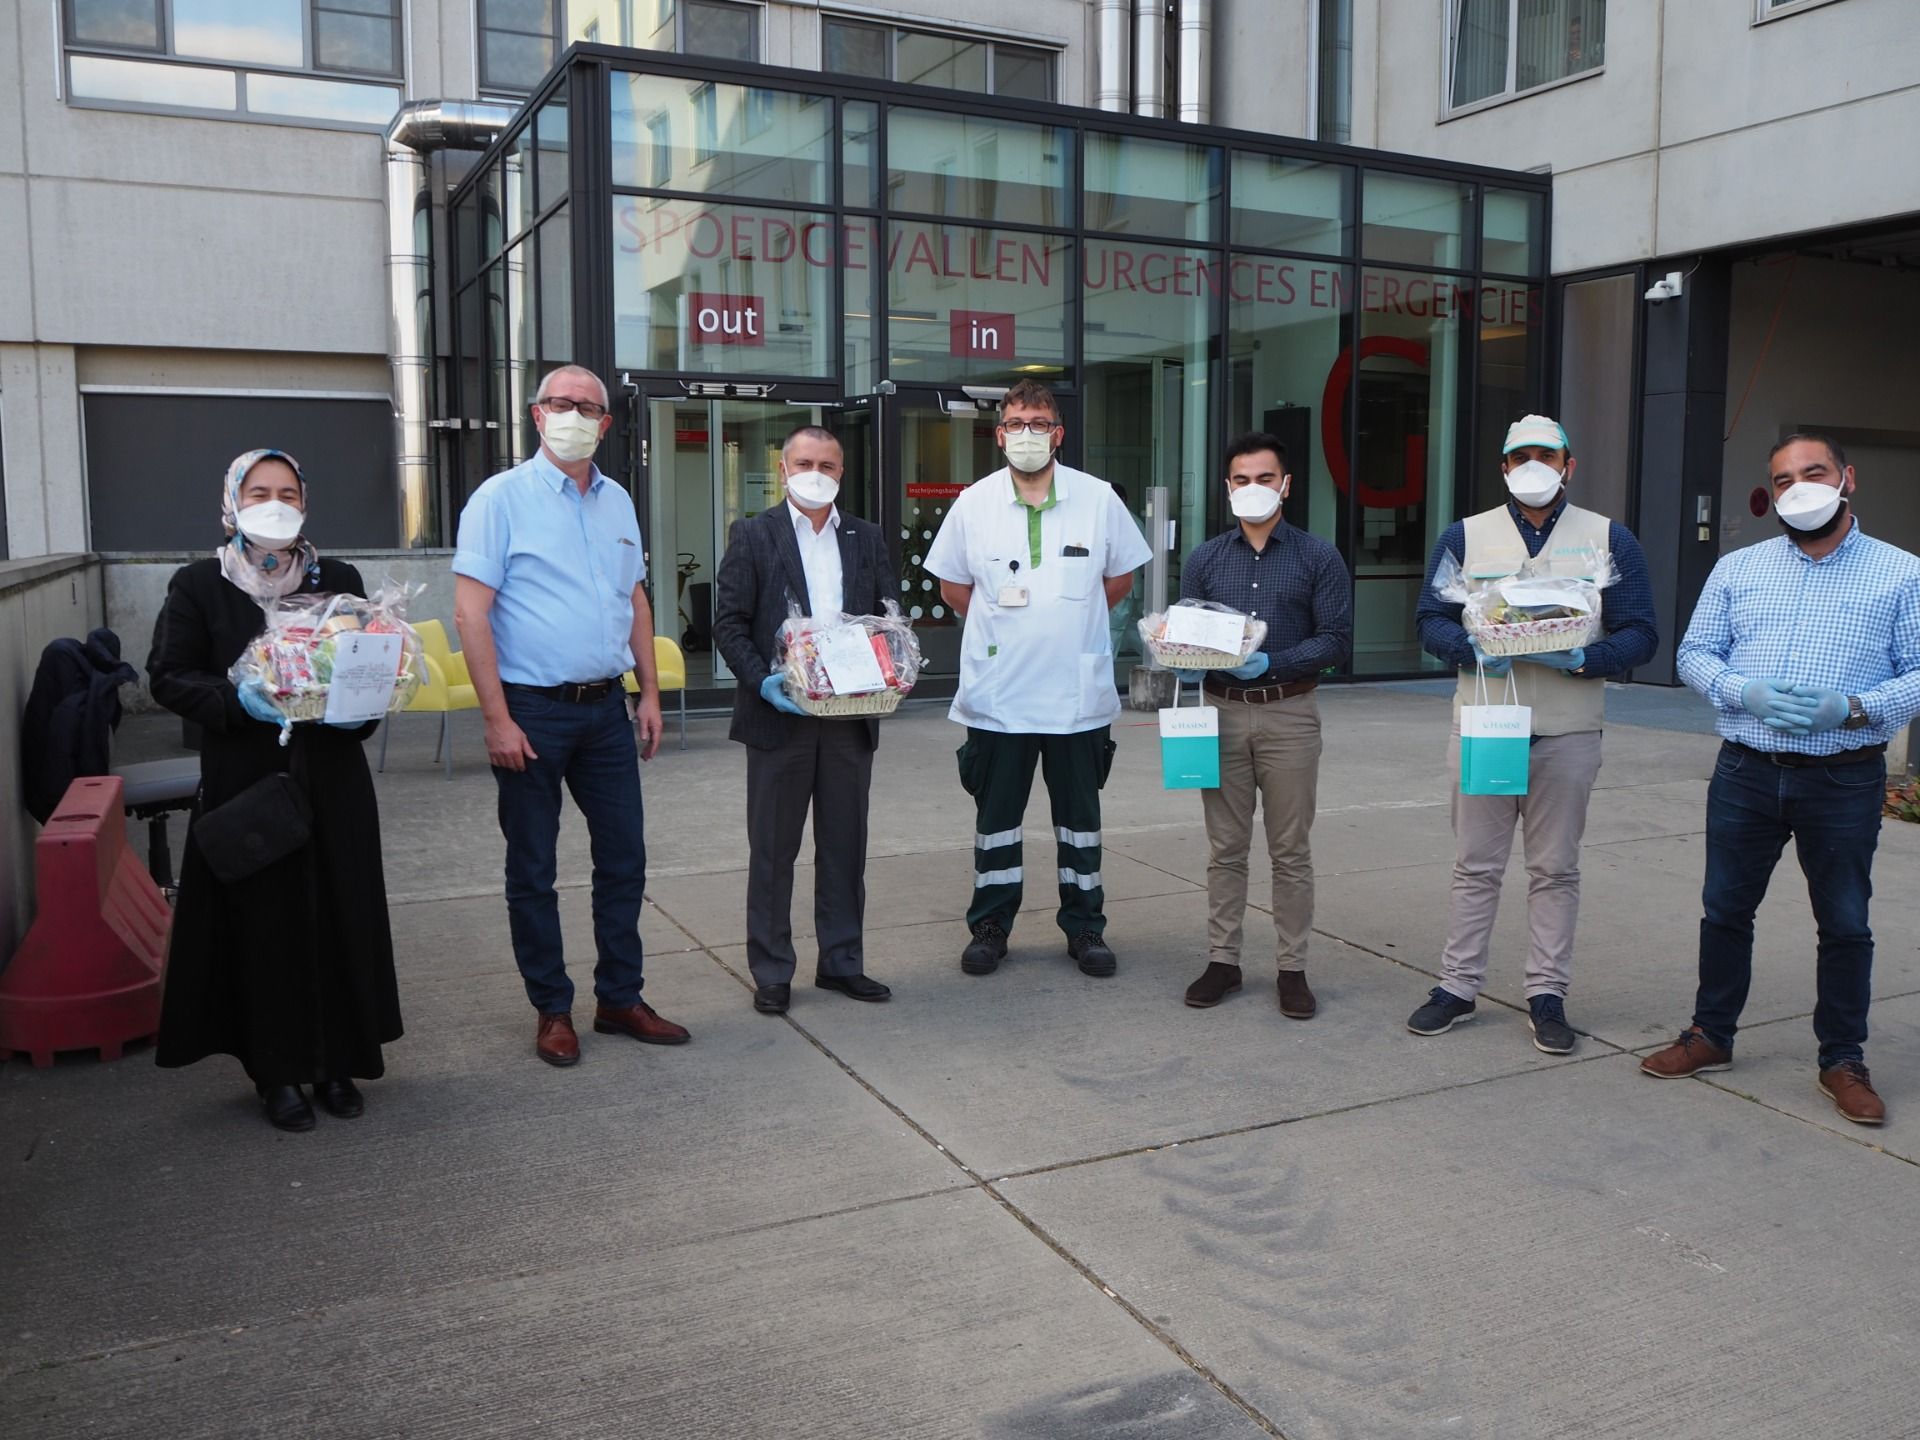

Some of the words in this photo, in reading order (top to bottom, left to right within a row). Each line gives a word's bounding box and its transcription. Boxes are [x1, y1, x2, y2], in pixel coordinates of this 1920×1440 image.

[619, 205, 1051, 288] SPOEDGEVALLEN
[1082, 247, 1296, 305] URGENCES
[1310, 269, 1543, 328] EMERGENCIES
[697, 306, 758, 336] out
[971, 319, 999, 350] in
